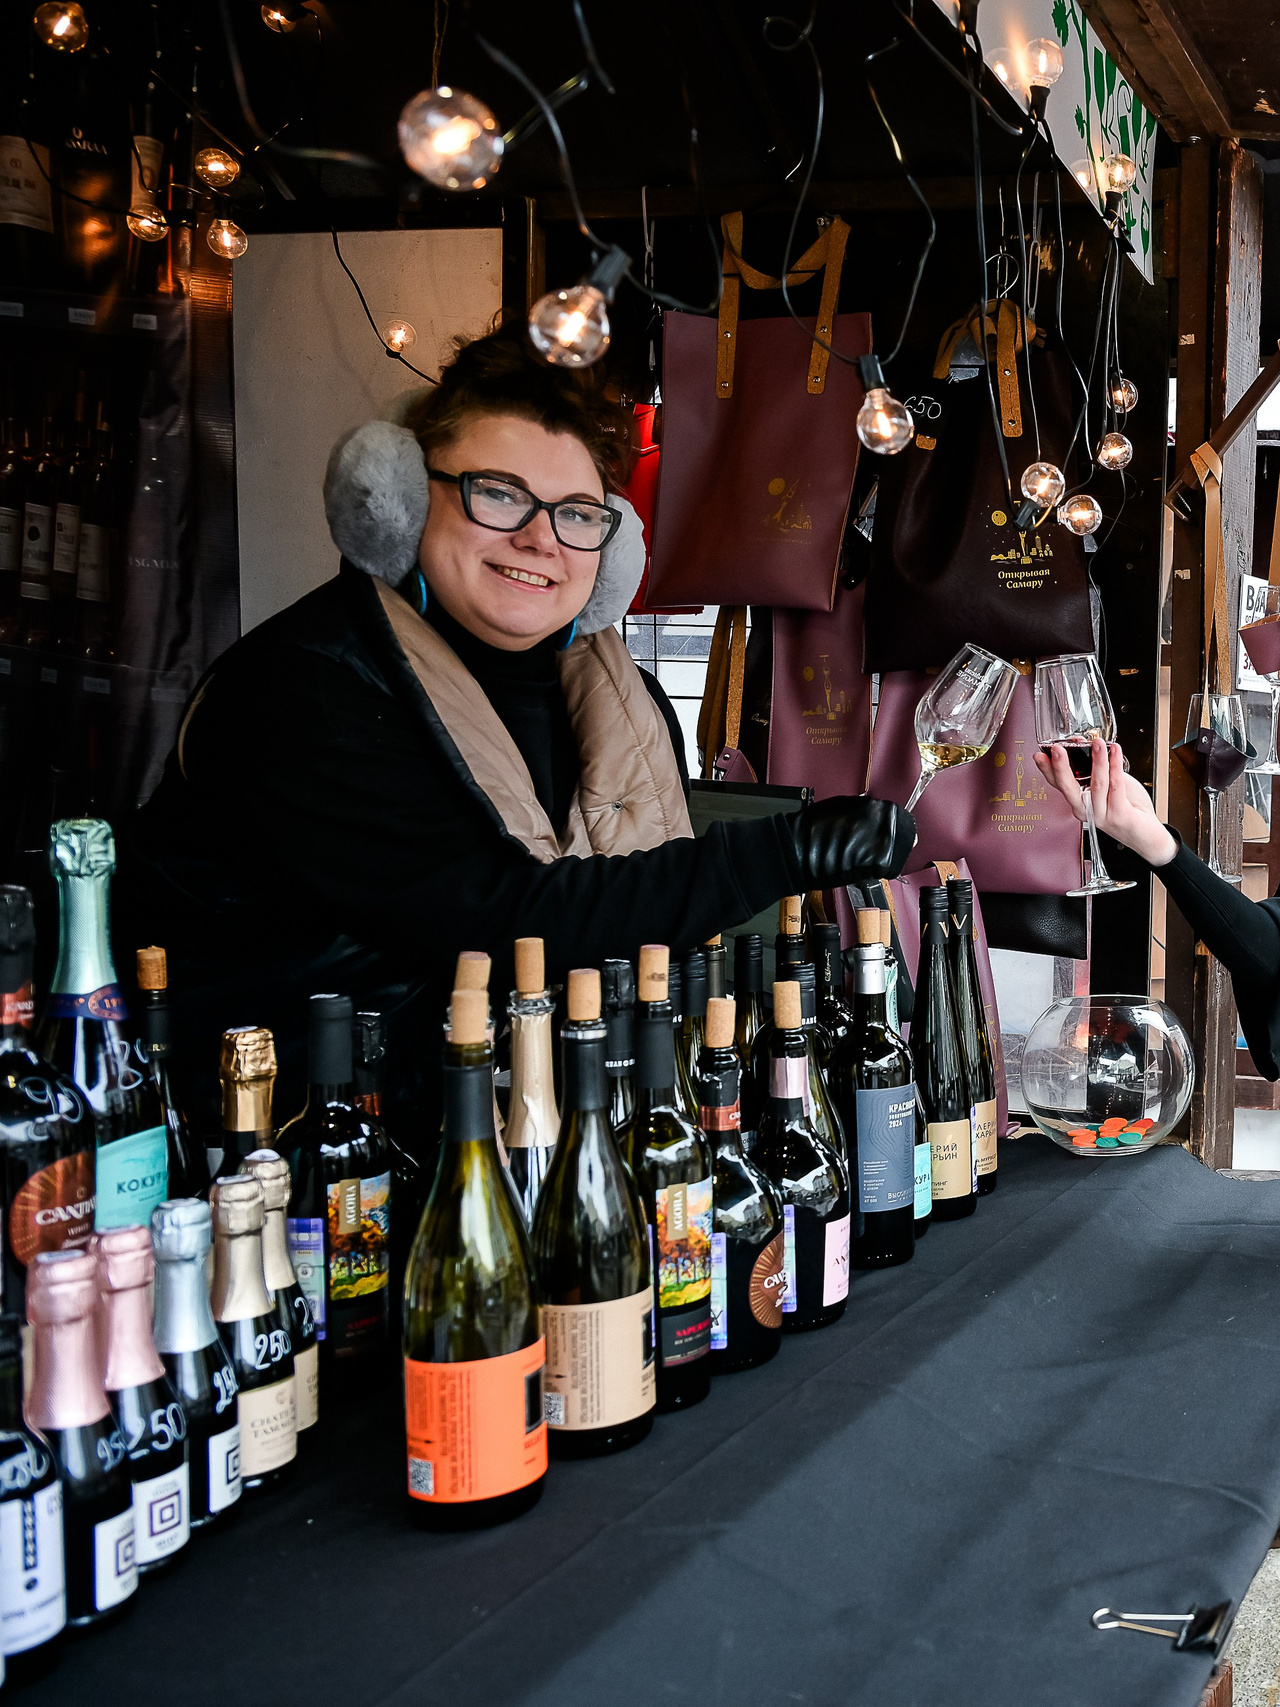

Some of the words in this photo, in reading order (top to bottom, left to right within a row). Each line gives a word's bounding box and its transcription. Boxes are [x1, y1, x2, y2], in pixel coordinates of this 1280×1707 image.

[903, 396, 942, 419] 650
[998, 568, 1050, 580] Открывая
[1006, 580, 1043, 589] Самару
[811, 736, 842, 746] Самару
[991, 813, 1042, 824] Открывая
[997, 824, 1035, 834] Самару
[930, 1142, 958, 1153] ЕРИЙ
[931, 1152, 958, 1161] РЬИН
[345, 1184, 357, 1226] AGORA
[673, 1190, 684, 1231] AGORA
[254, 1329, 292, 1370] 250
